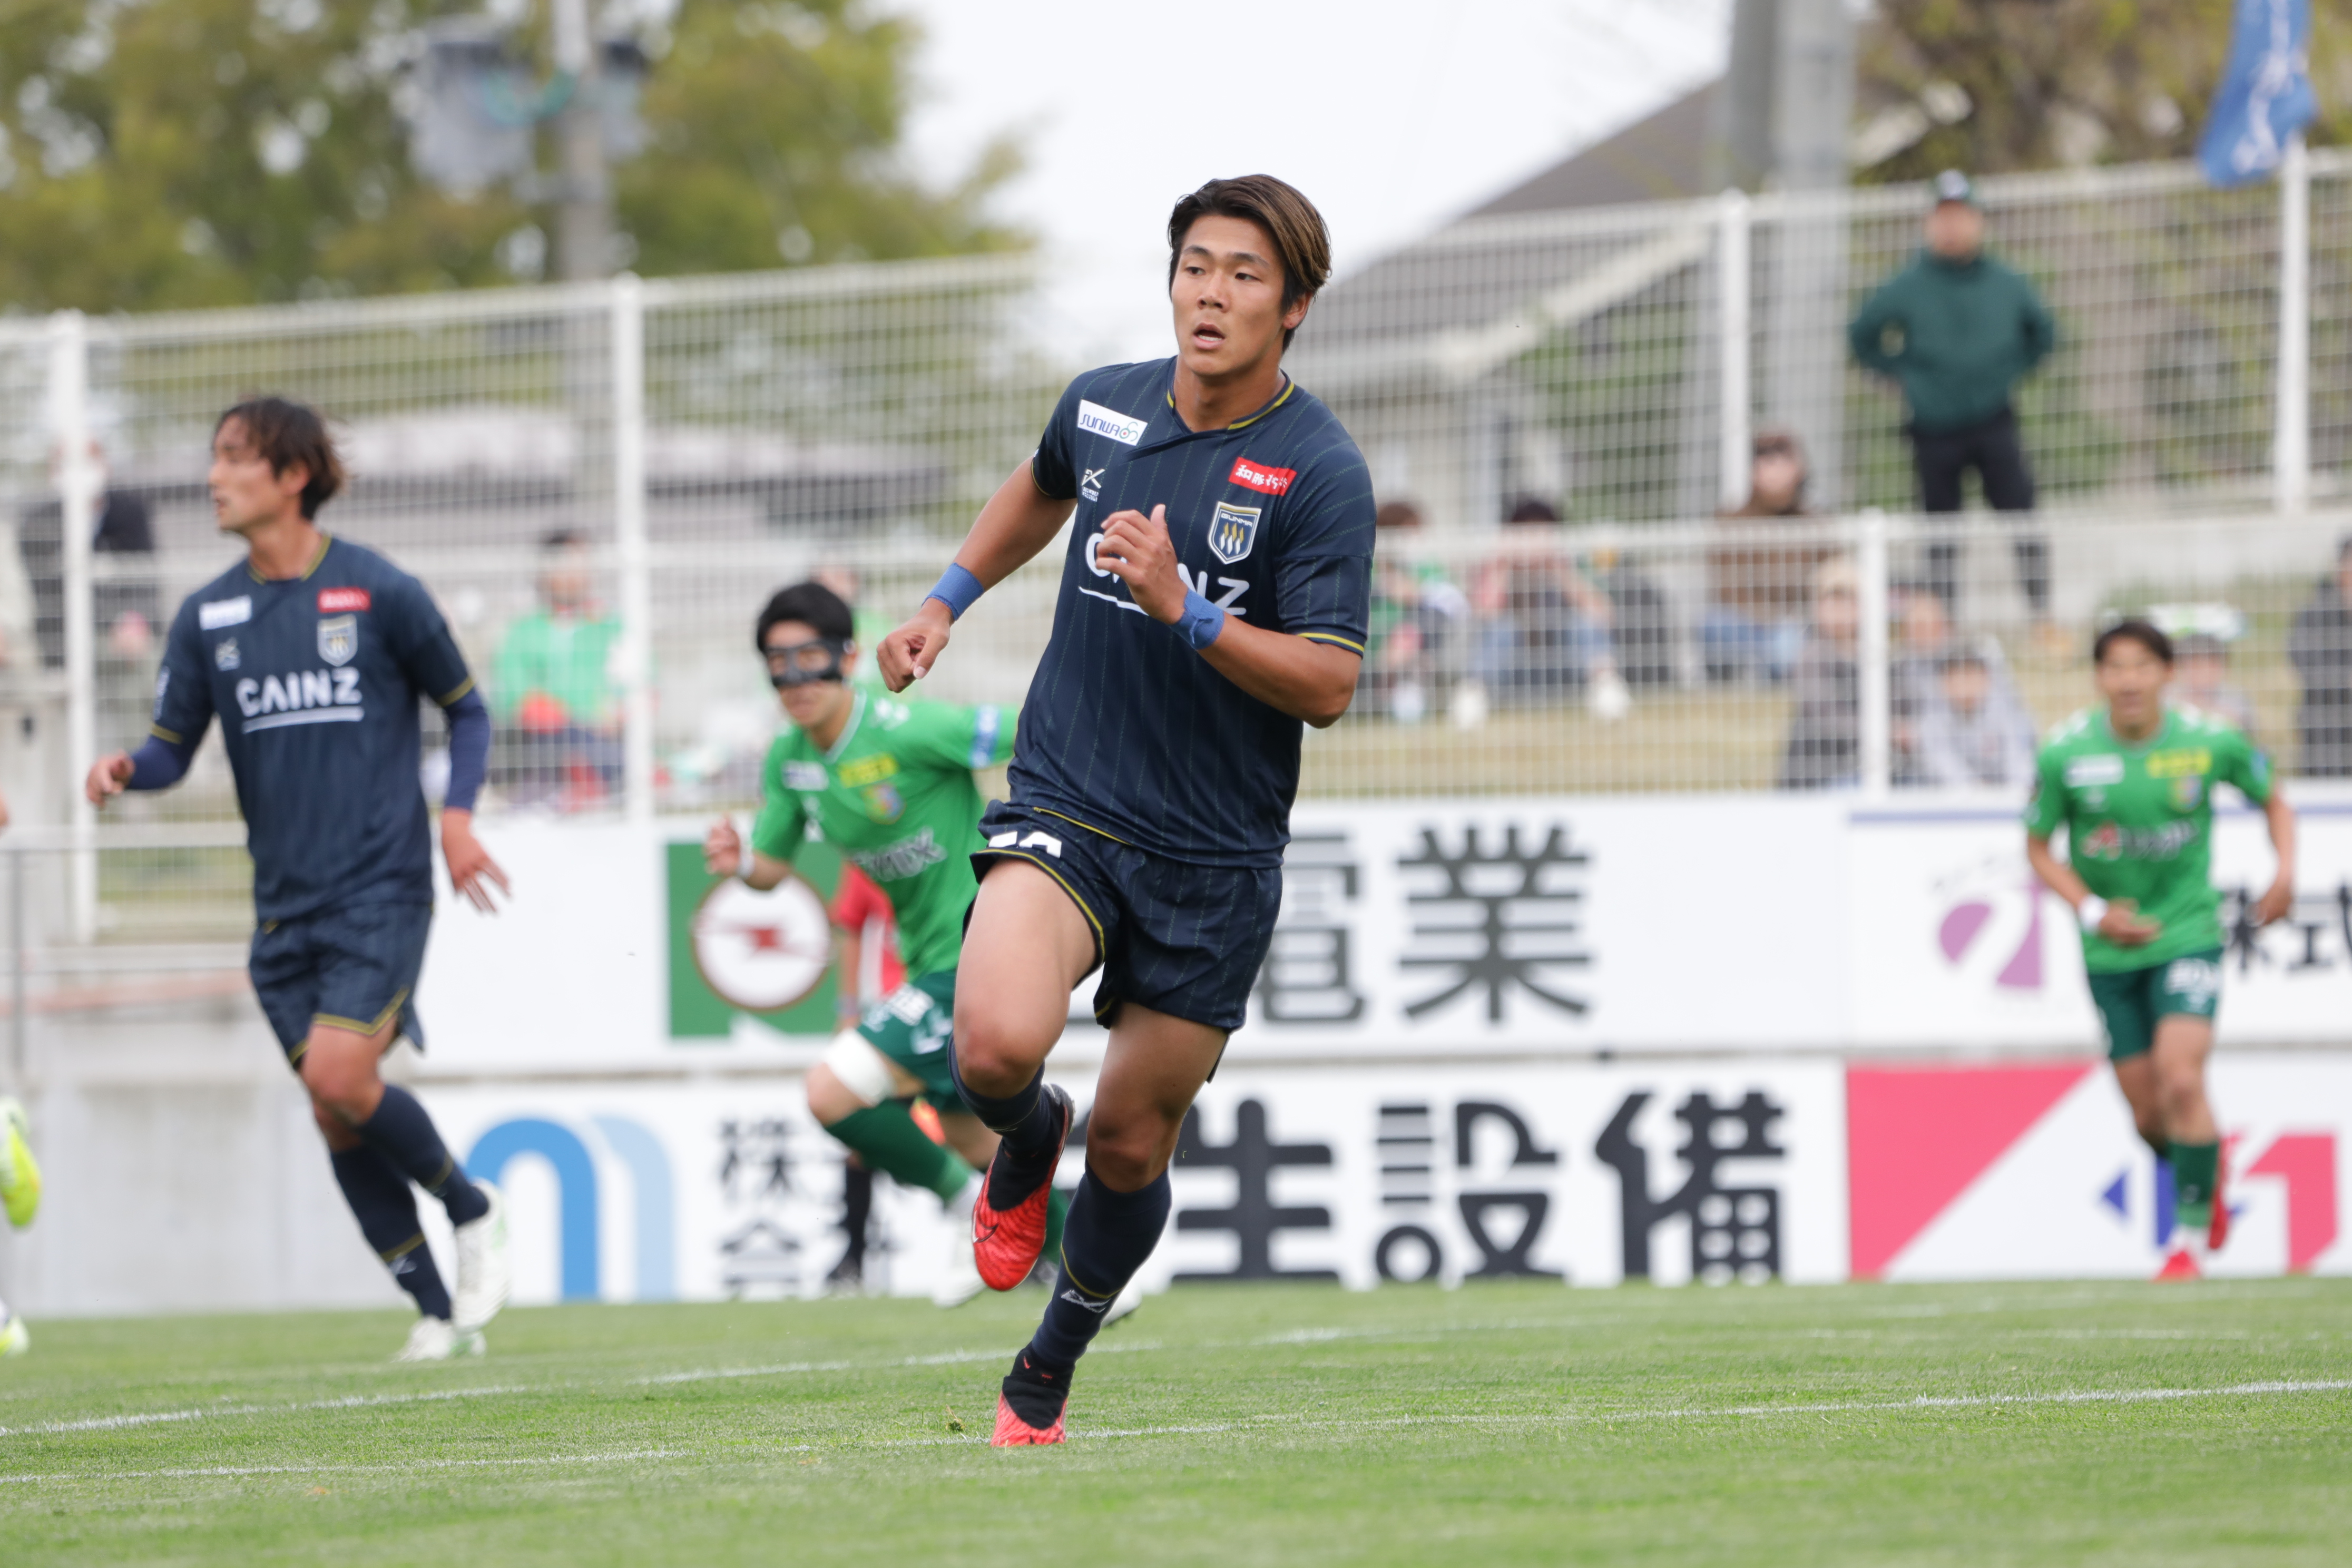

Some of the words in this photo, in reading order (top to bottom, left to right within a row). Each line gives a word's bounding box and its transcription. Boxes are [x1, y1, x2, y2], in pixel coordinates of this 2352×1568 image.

[1221, 513, 1253, 528] GUNMA
[1086, 532, 1250, 616] CNZ
[236, 667, 362, 717] CAINZ
[1059, 1091, 1786, 1280] 生設備
